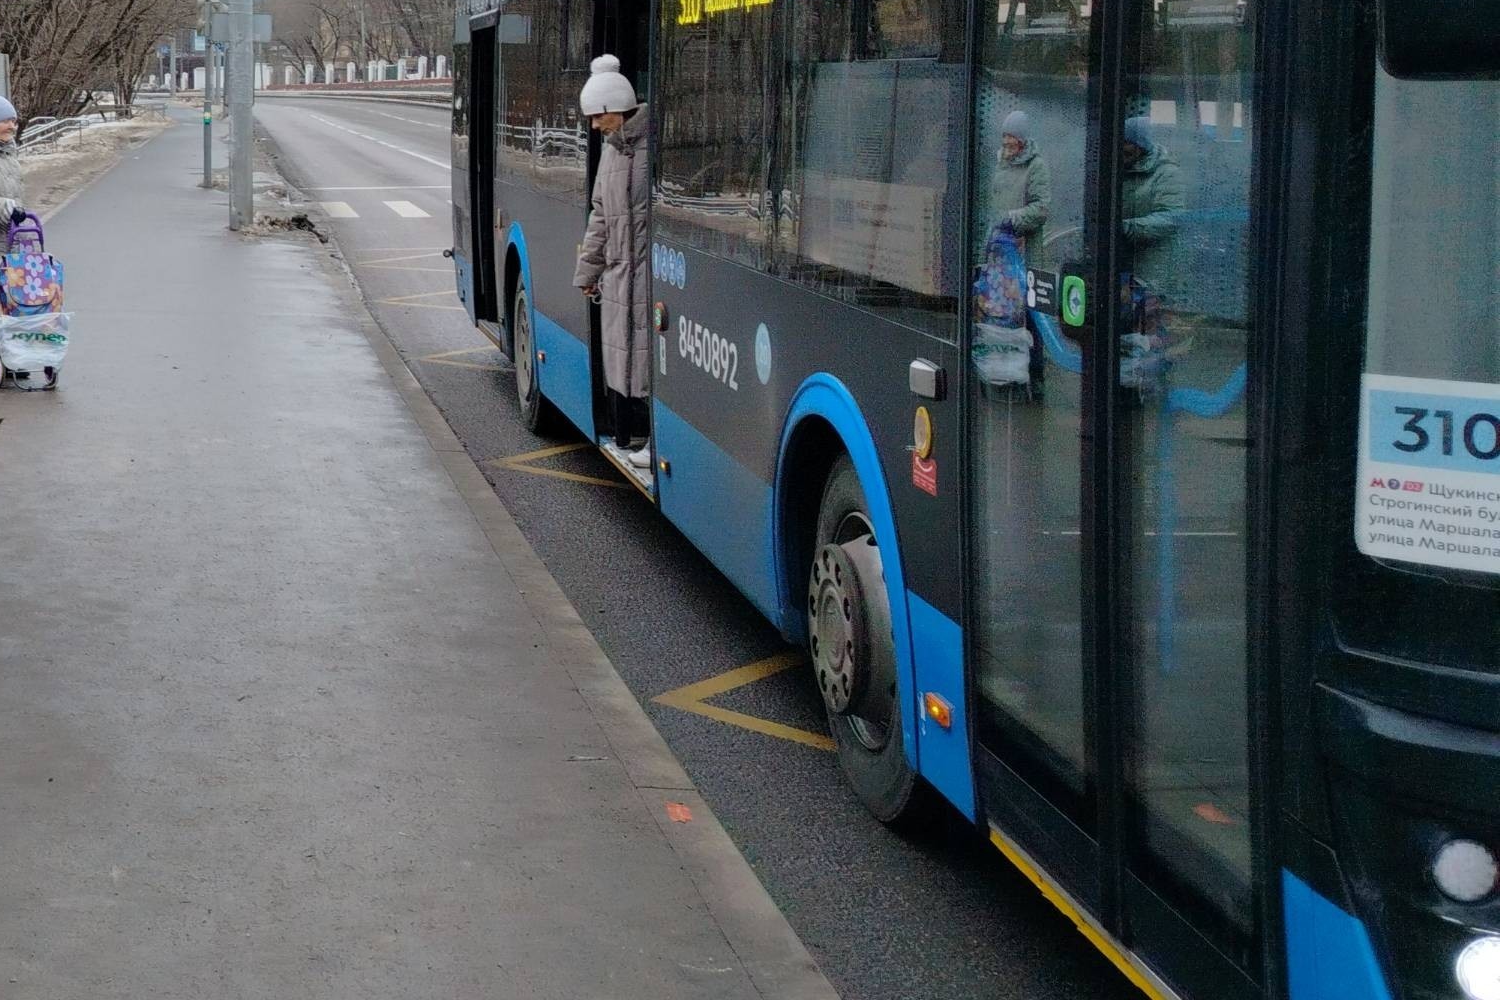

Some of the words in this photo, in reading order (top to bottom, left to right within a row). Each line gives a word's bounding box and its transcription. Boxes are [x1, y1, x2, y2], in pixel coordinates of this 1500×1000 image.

[678, 314, 739, 391] 8450892
[1392, 405, 1500, 460] 310
[1369, 493, 1472, 518] Строгинский
[1477, 506, 1500, 522] бу
[1369, 514, 1414, 529] улица
[1419, 519, 1500, 539] Маршала
[1369, 532, 1414, 548] улица
[1419, 537, 1500, 557] Маршала
